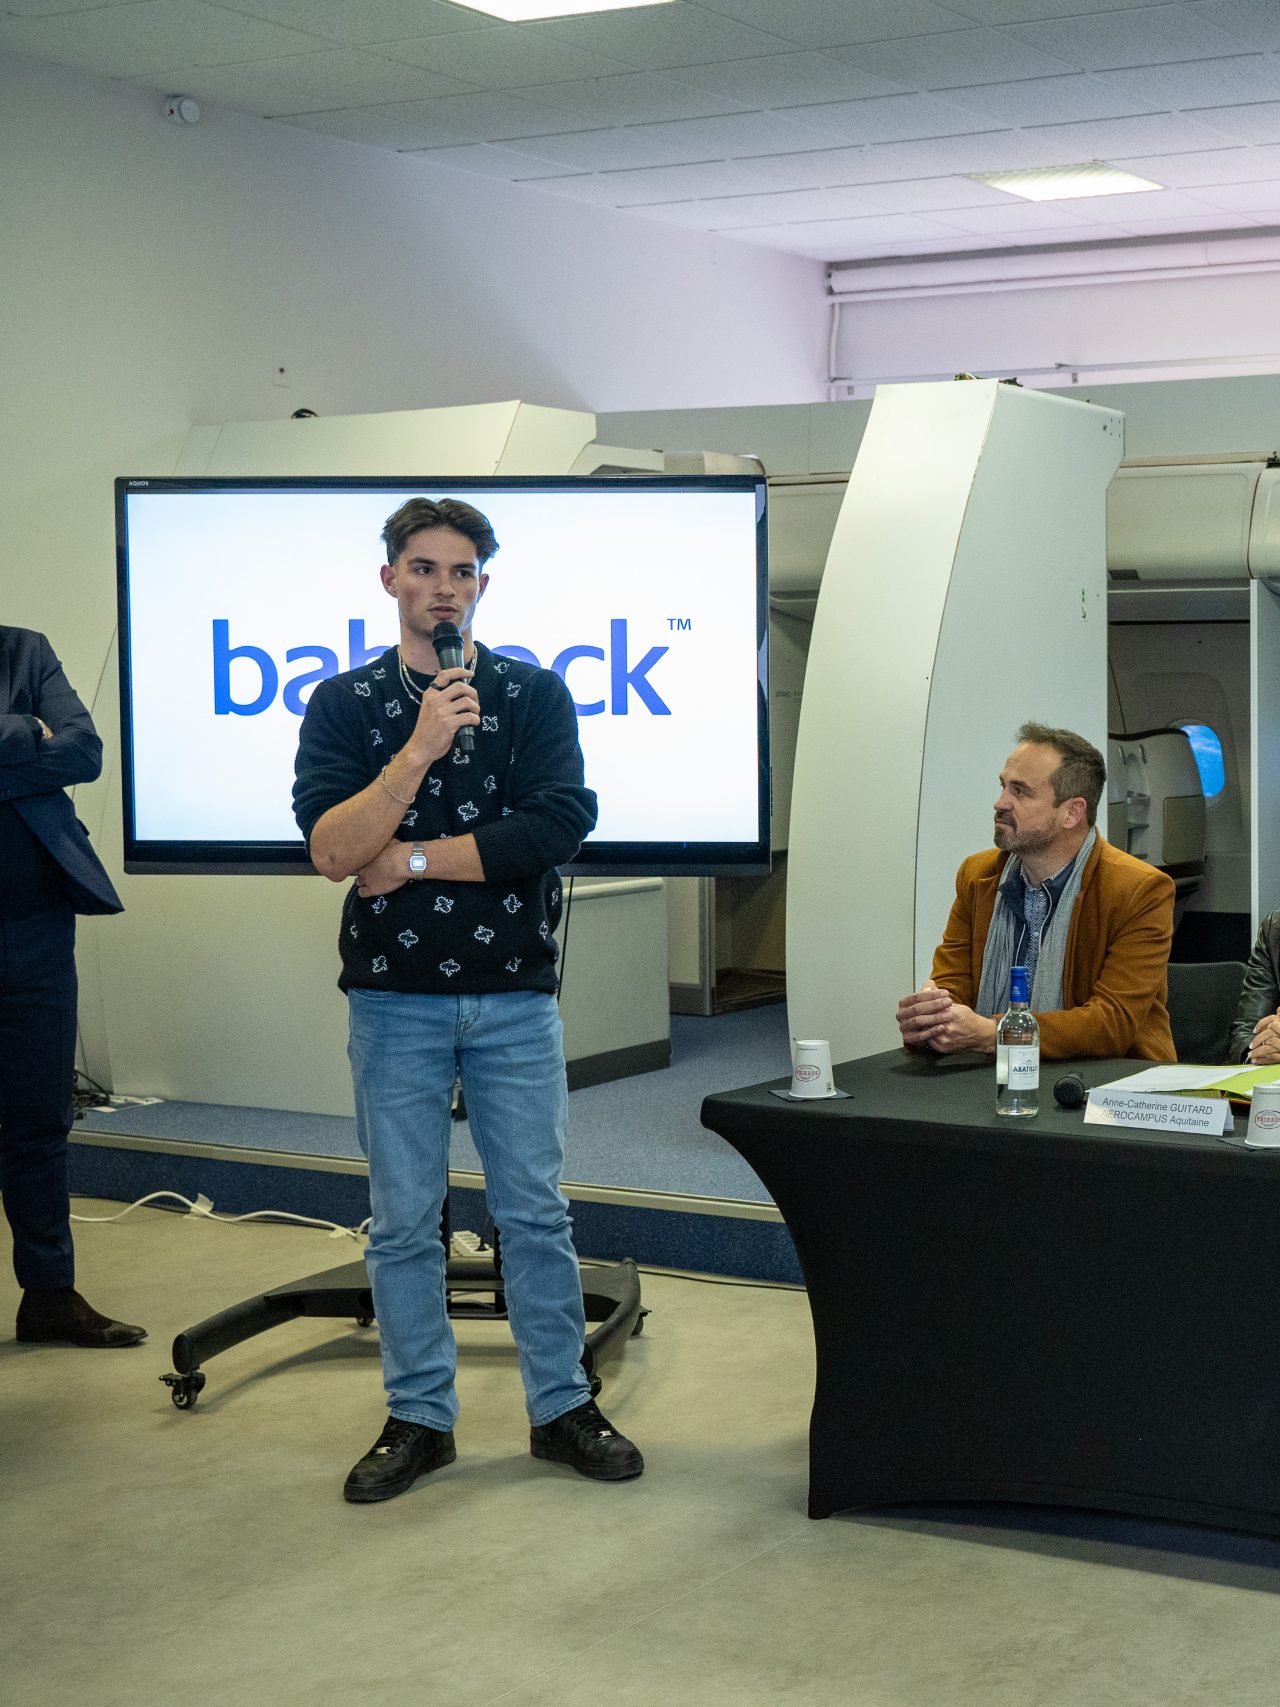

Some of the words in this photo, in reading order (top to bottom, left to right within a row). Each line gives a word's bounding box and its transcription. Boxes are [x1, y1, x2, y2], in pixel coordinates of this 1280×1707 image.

[212, 618, 671, 717] back
[1102, 1097, 1168, 1111] Anne-Catherine
[1169, 1103, 1213, 1115] GUITARD
[1169, 1115, 1210, 1127] Aquitaine
